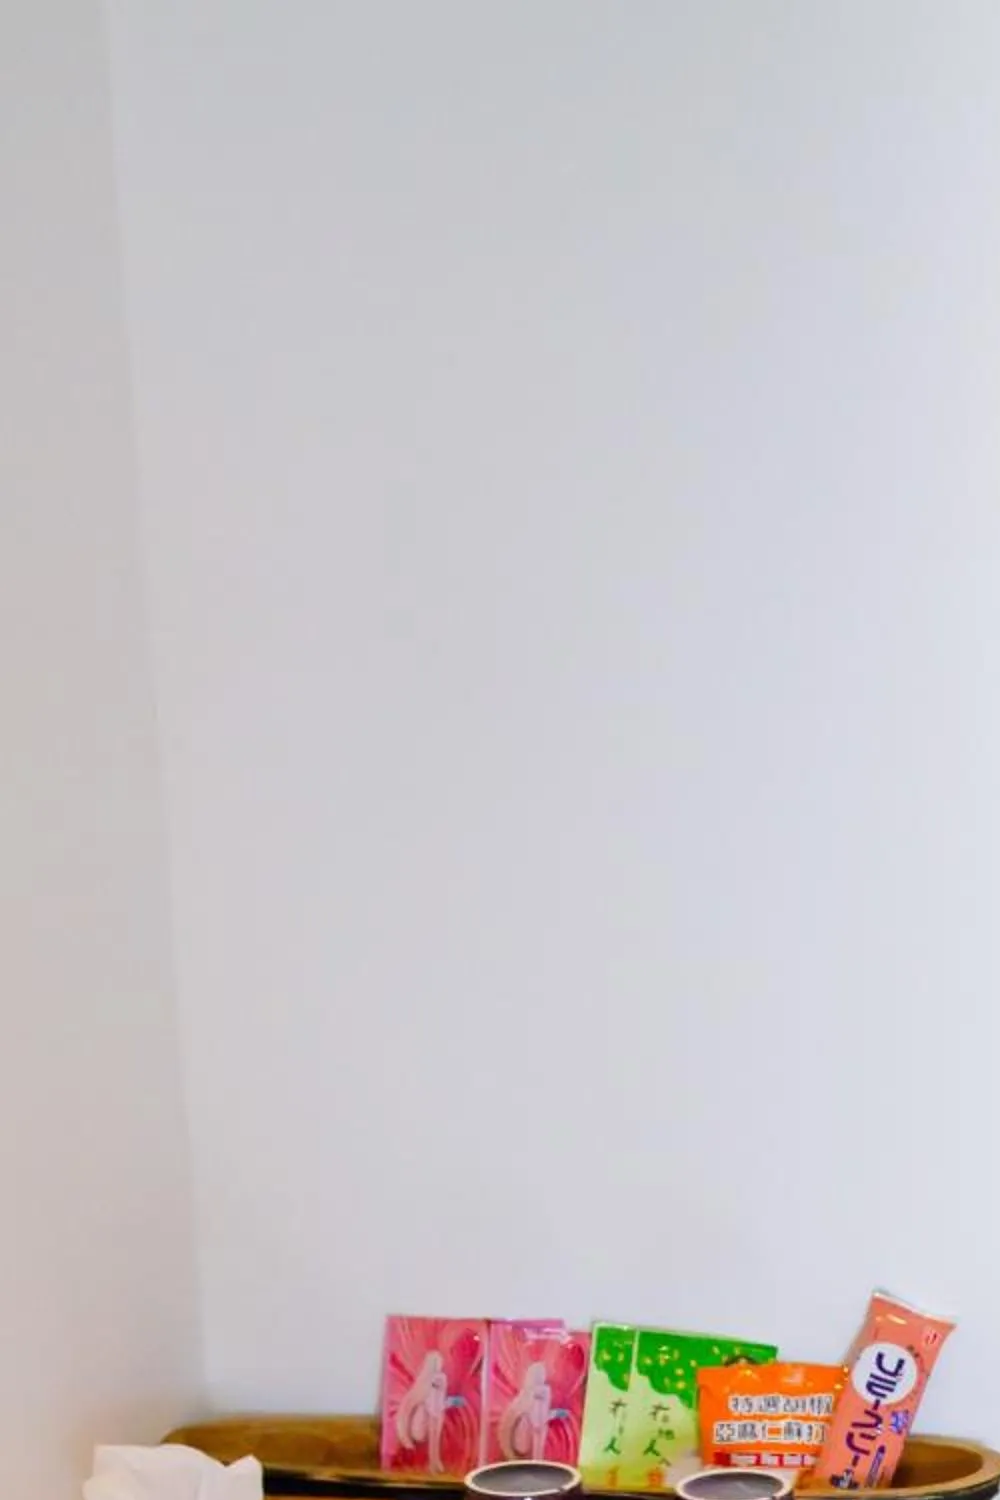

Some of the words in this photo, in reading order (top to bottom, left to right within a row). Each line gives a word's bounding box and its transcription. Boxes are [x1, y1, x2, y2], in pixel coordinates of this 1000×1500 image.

[845, 1351, 906, 1467] ブルーベリー
